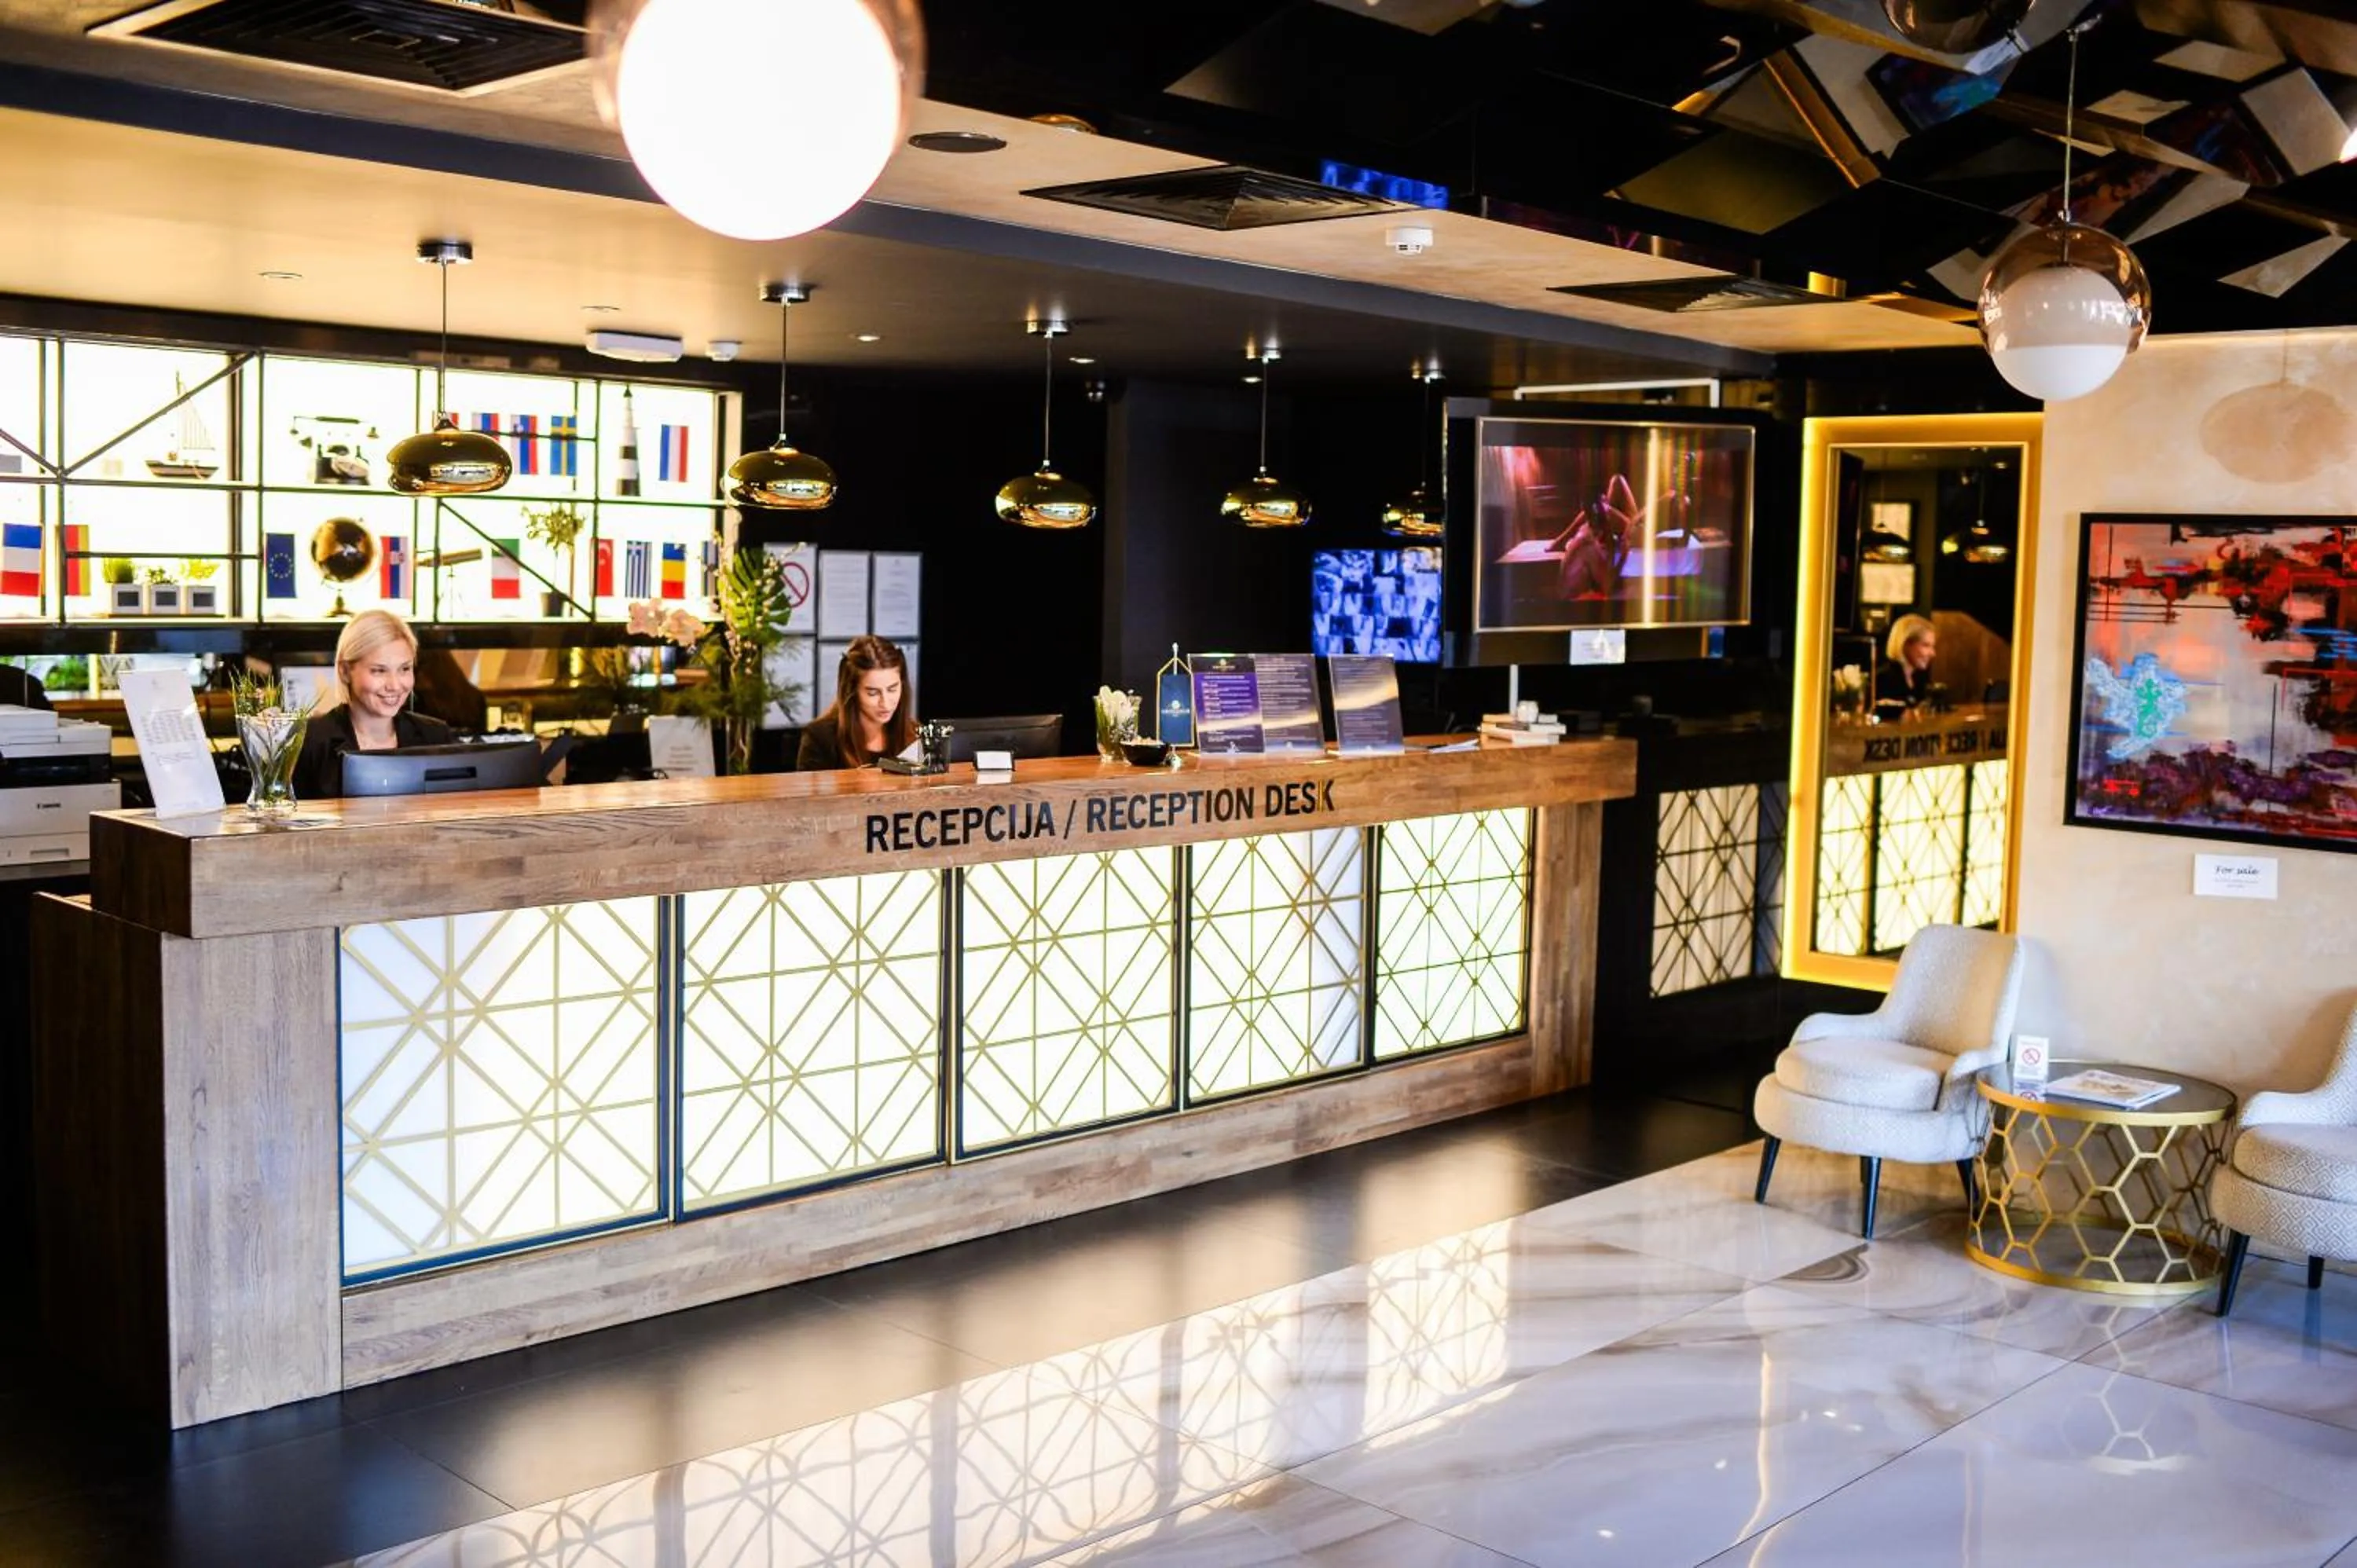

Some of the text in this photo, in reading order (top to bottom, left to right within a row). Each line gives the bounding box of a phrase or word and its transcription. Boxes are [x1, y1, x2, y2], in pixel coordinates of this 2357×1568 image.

[866, 779, 1335, 854] RECEPCIJA / RECEPTION DESK
[2214, 864, 2260, 875] For sale
